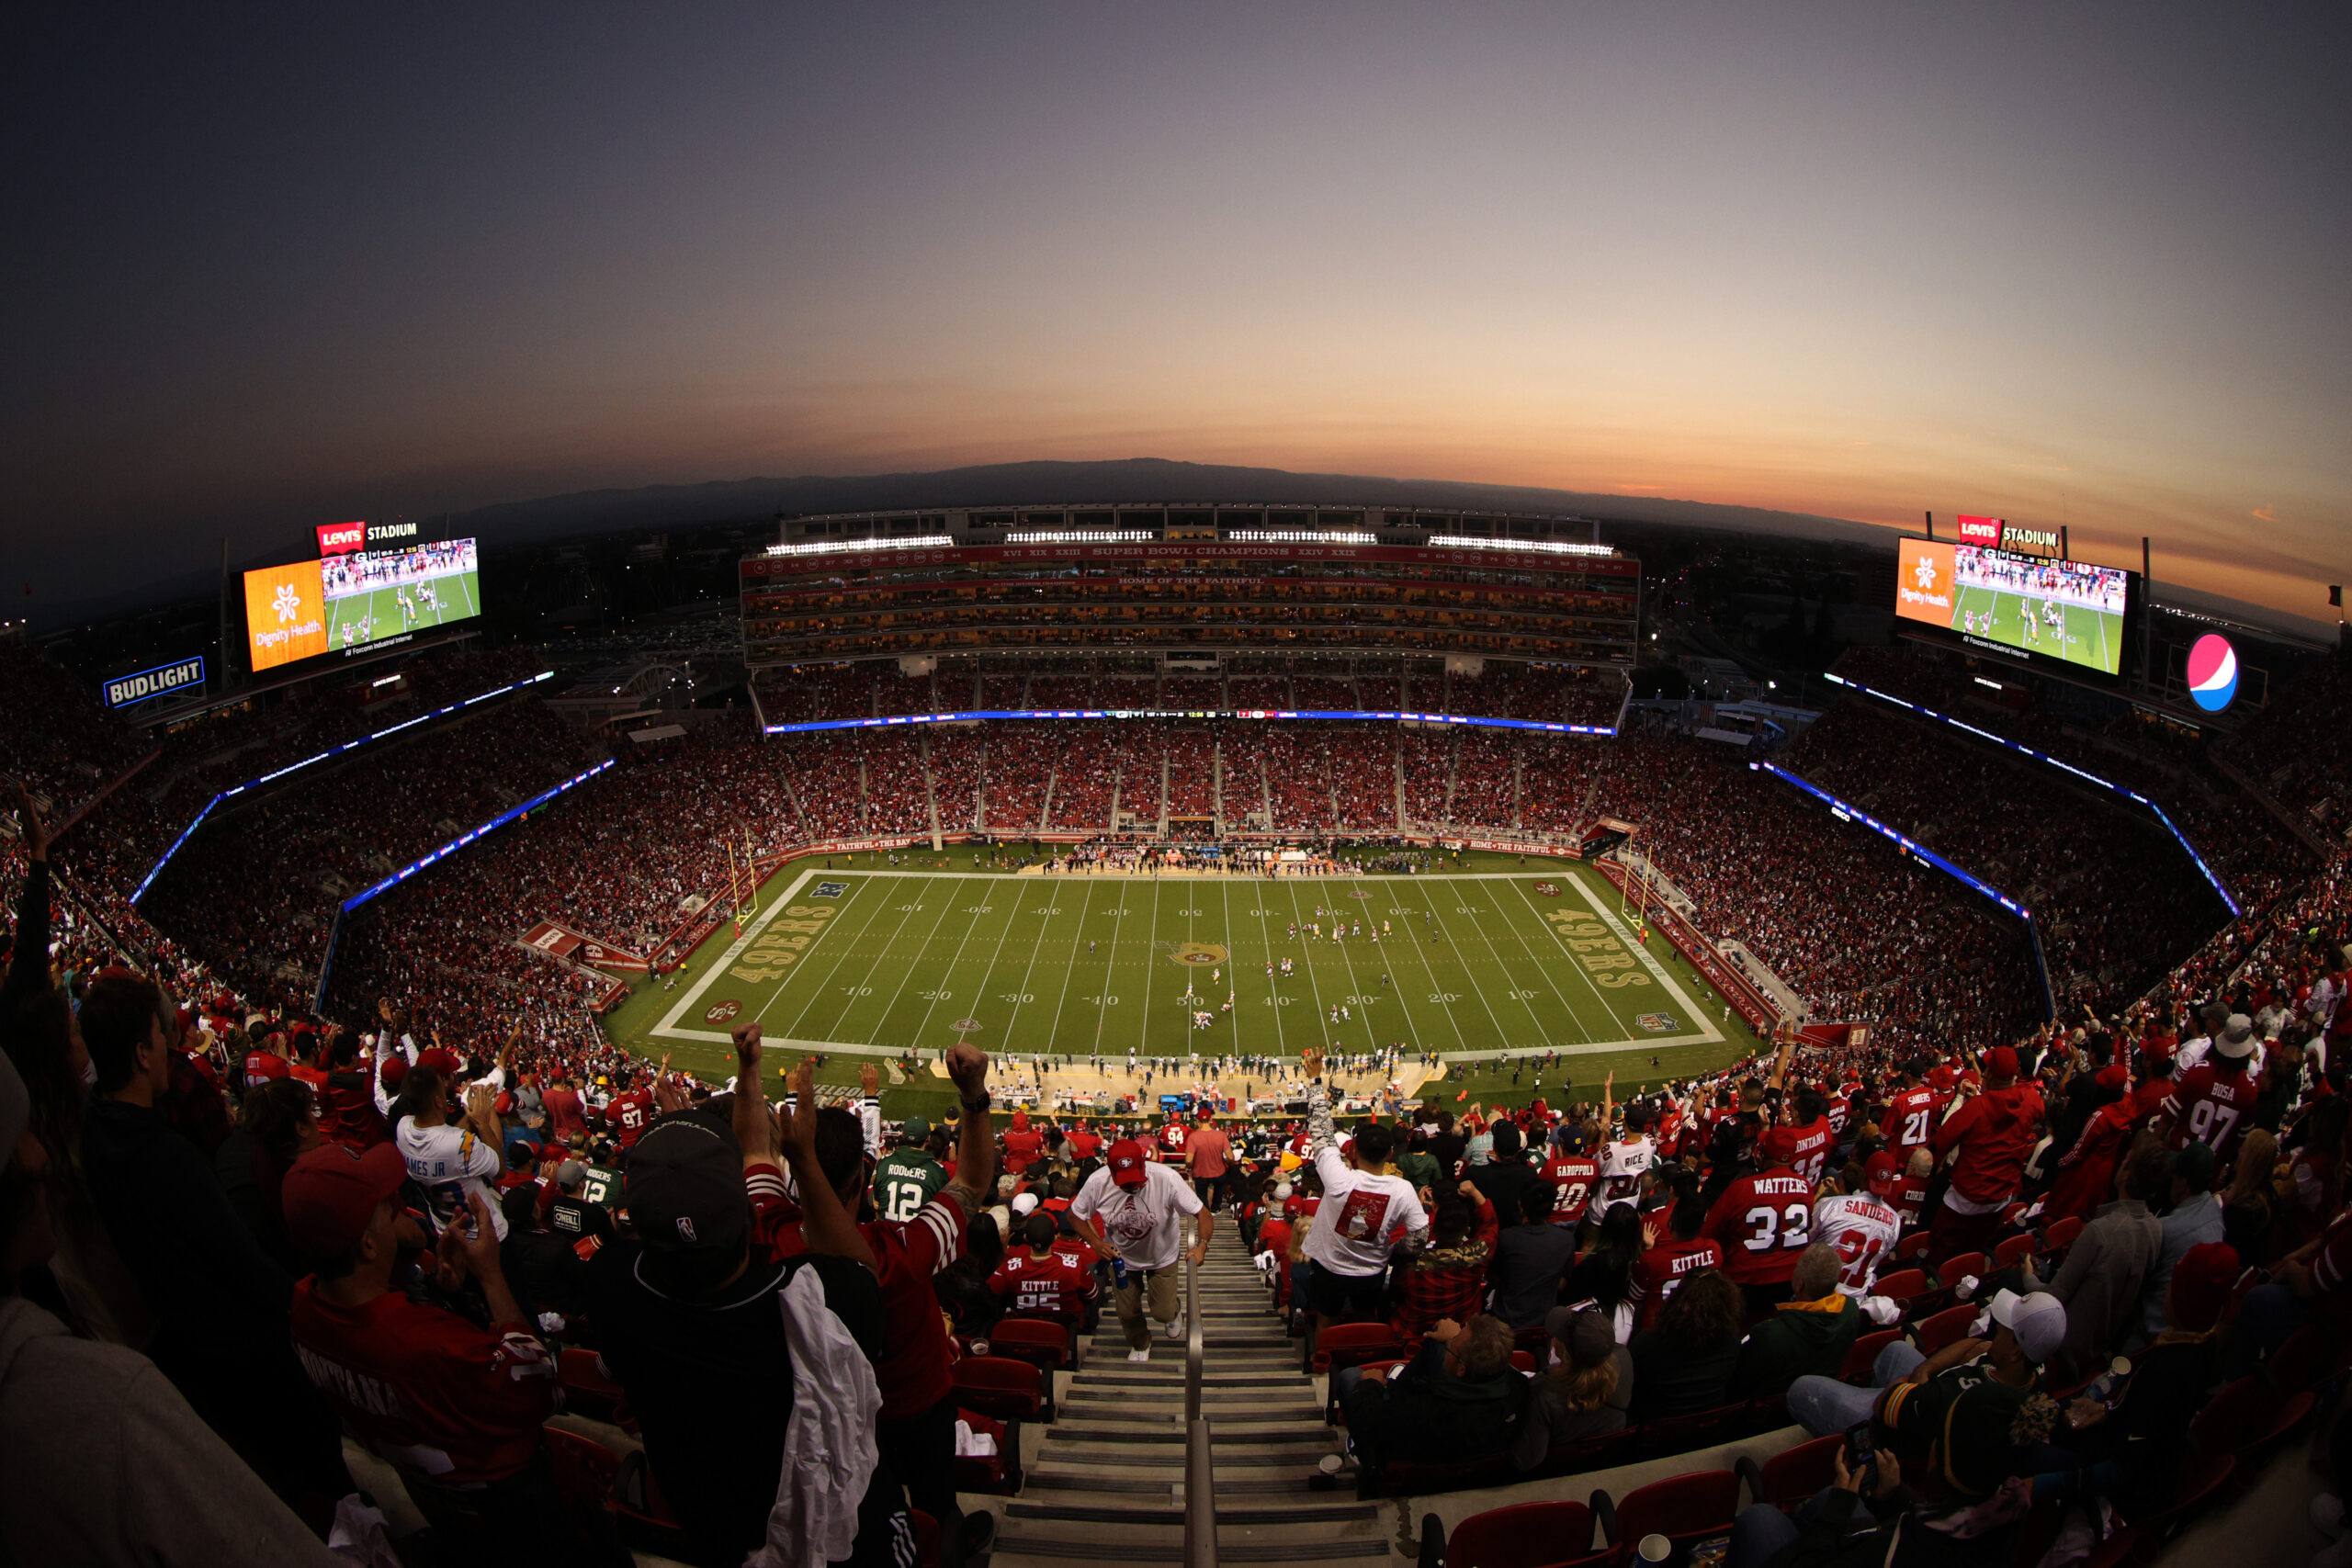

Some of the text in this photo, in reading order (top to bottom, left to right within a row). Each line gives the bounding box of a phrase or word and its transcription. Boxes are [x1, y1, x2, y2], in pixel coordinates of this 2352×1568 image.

[368, 523, 417, 540] STADIUM
[2004, 526, 2058, 547] STADIUM
[1092, 547, 1145, 556] SUPER
[1148, 547, 1193, 555] BOWL
[1196, 547, 1290, 556] CHAMPIONS
[1901, 589, 1949, 607] Dignity Health
[255, 619, 322, 647] Dignity Health
[1970, 636, 1989, 648] Foxconn
[352, 644, 374, 655] Foxconn
[837, 840, 874, 851] FAITHFUL
[1470, 840, 1492, 849] HOME
[1513, 844, 1550, 853] FAITHFUL
[729, 905, 836, 984] 49ERS
[1544, 908, 1653, 988] 49ERS
[812, 1084, 888, 1098] WELCOE
[2211, 1081, 2235, 1101] BOSA
[622, 1109, 644, 1129] 97
[1902, 1109, 1929, 1146] 21
[2189, 1098, 2241, 1154] 97
[1167, 1130, 1184, 1145] 94
[1794, 1131, 1826, 1154] ONTANA
[406, 1156, 446, 1177] AMES JR
[1556, 1164, 1595, 1178] GAROPPOLO
[1623, 1154, 1644, 1168] RICE
[888, 1164, 927, 1180] RODGERS
[582, 1179, 607, 1204] 12
[1753, 1177, 1809, 1195] WATTERS
[884, 1180, 923, 1224] 12
[1552, 1182, 1587, 1212] 10
[1845, 1200, 1894, 1226] SANDERS
[1743, 1203, 1810, 1251] 32
[1671, 1249, 1714, 1274] KITTLE
[1838, 1228, 1883, 1289] 21
[1021, 1280, 1059, 1292] KITTLE
